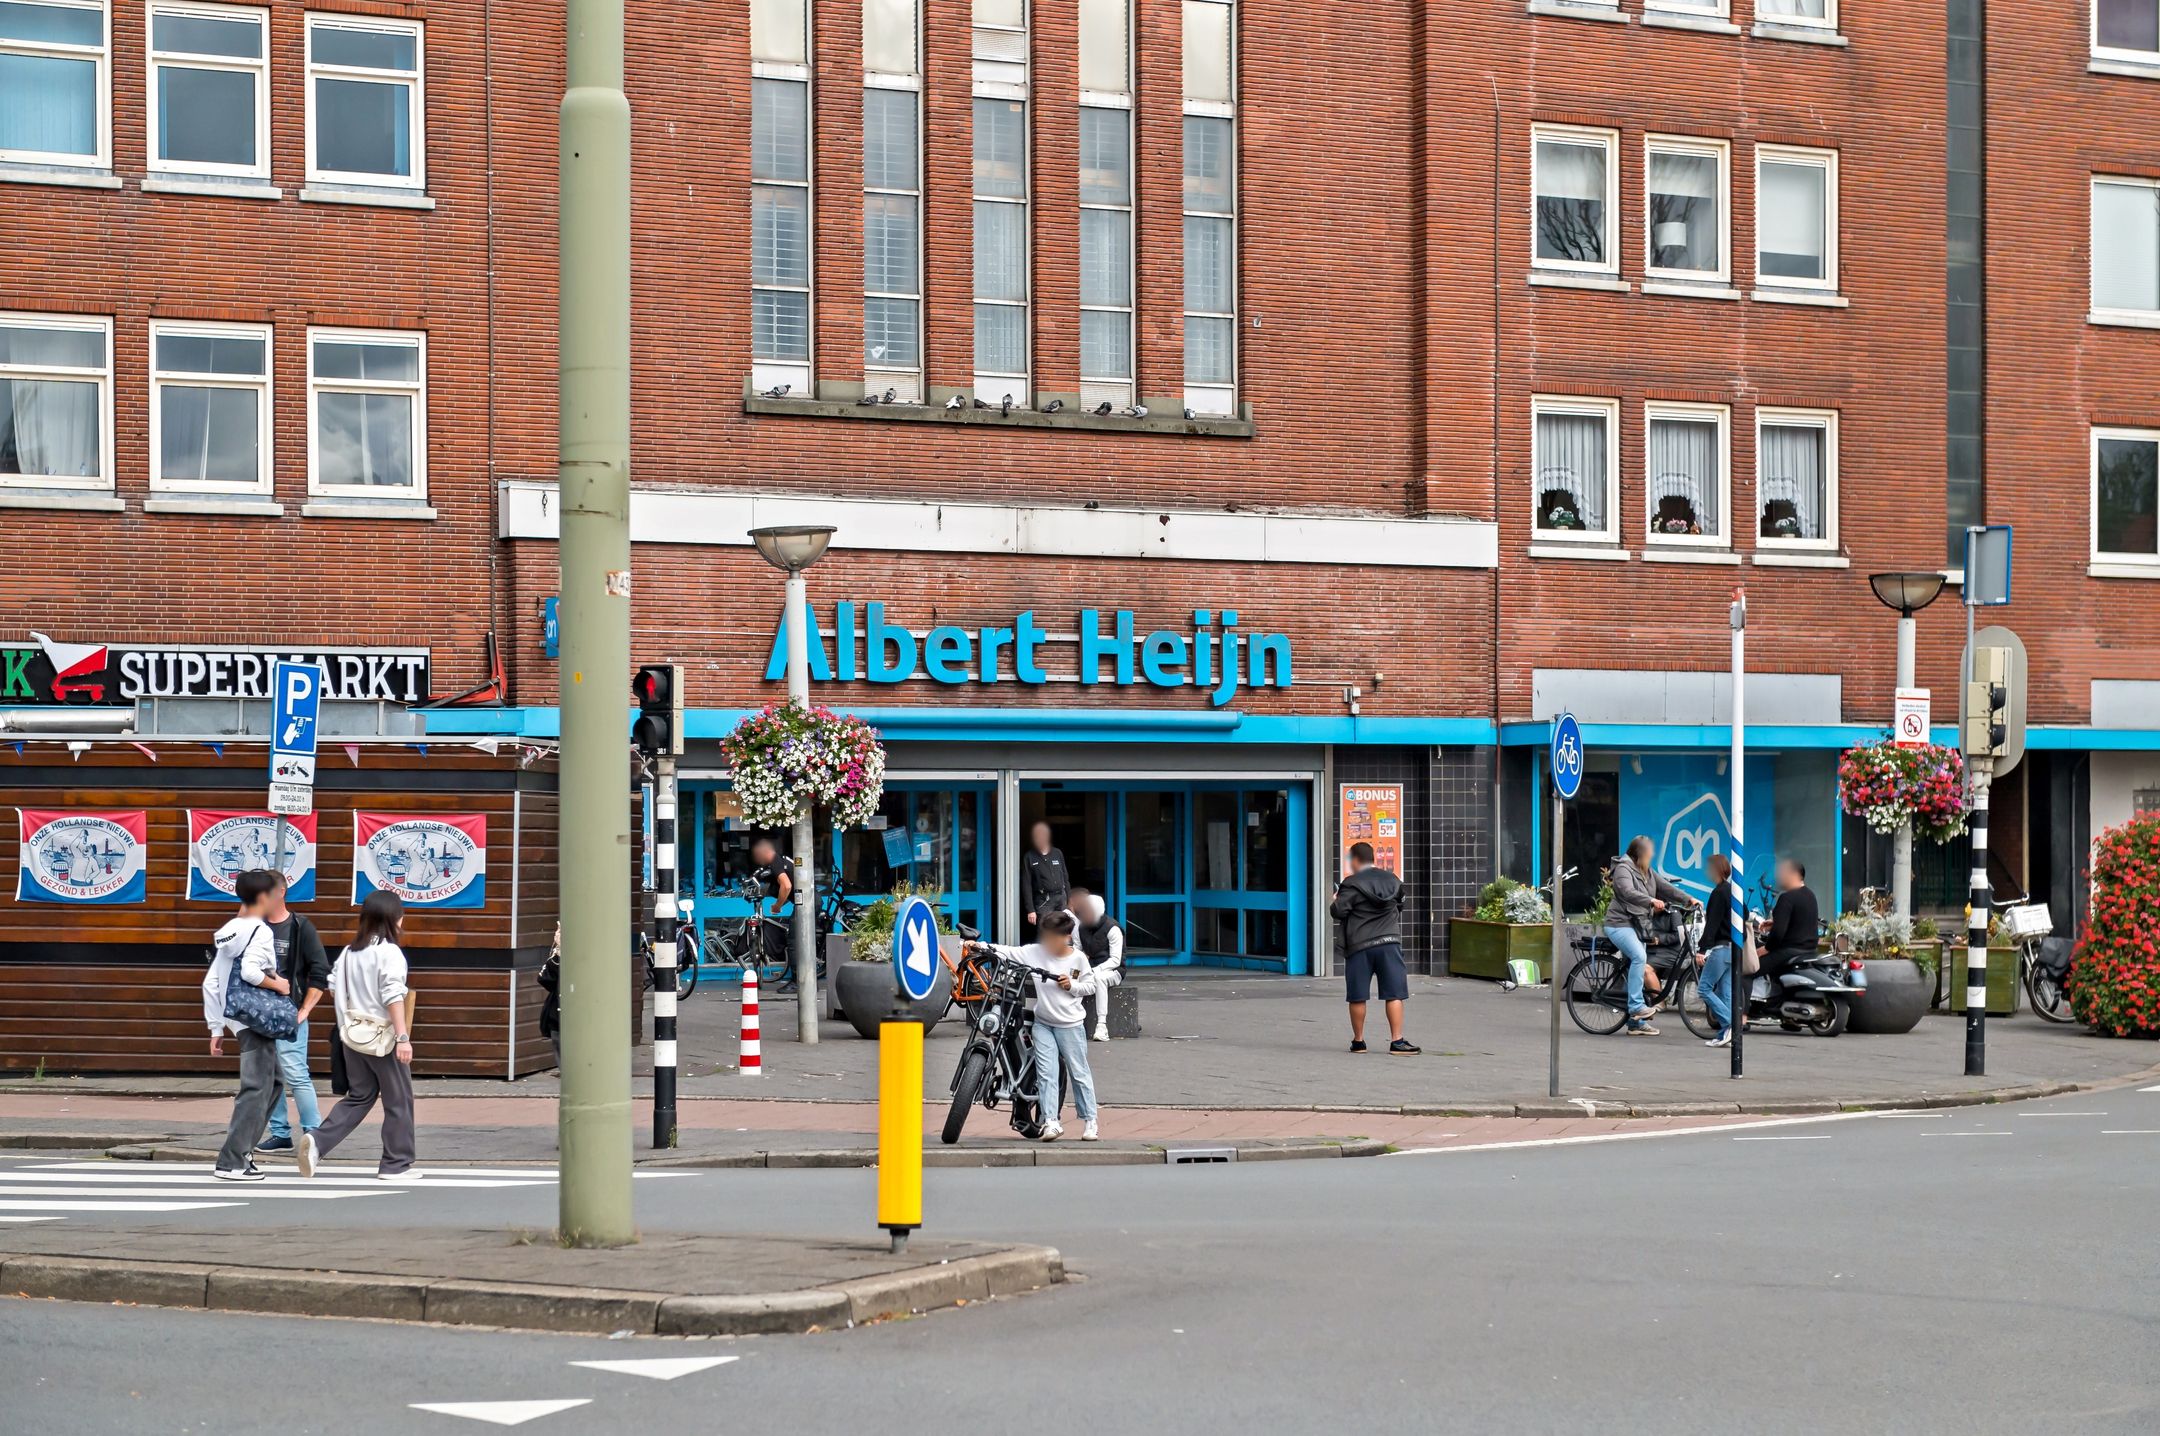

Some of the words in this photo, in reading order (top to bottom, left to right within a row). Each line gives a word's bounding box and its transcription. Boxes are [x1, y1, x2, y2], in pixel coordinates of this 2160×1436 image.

[764, 600, 1047, 685] Albert
[1080, 609, 1293, 707] Heijn
[0, 650, 35, 697] K
[286, 671, 312, 715] P
[1355, 790, 1397, 801] BONUS
[30, 828, 51, 847] ONZE
[51, 818, 105, 831] HOLLANDSE
[106, 823, 135, 849] NIEUWE
[200, 826, 222, 847] ONZE
[221, 817, 276, 830] HOLLANDSE
[285, 825, 305, 847] EUWE
[368, 831, 389, 850] ONZE
[389, 822, 444, 835] HOLLANDSE
[445, 826, 474, 853] NIEUWE
[40, 875, 78, 896] GEZOND
[80, 887, 86, 896] &
[89, 876, 125, 896] LEKKER
[210, 875, 237, 892] GEZO
[377, 879, 415, 900] GEZOND
[417, 891, 423, 900] &
[426, 880, 463, 899] LEKKER
